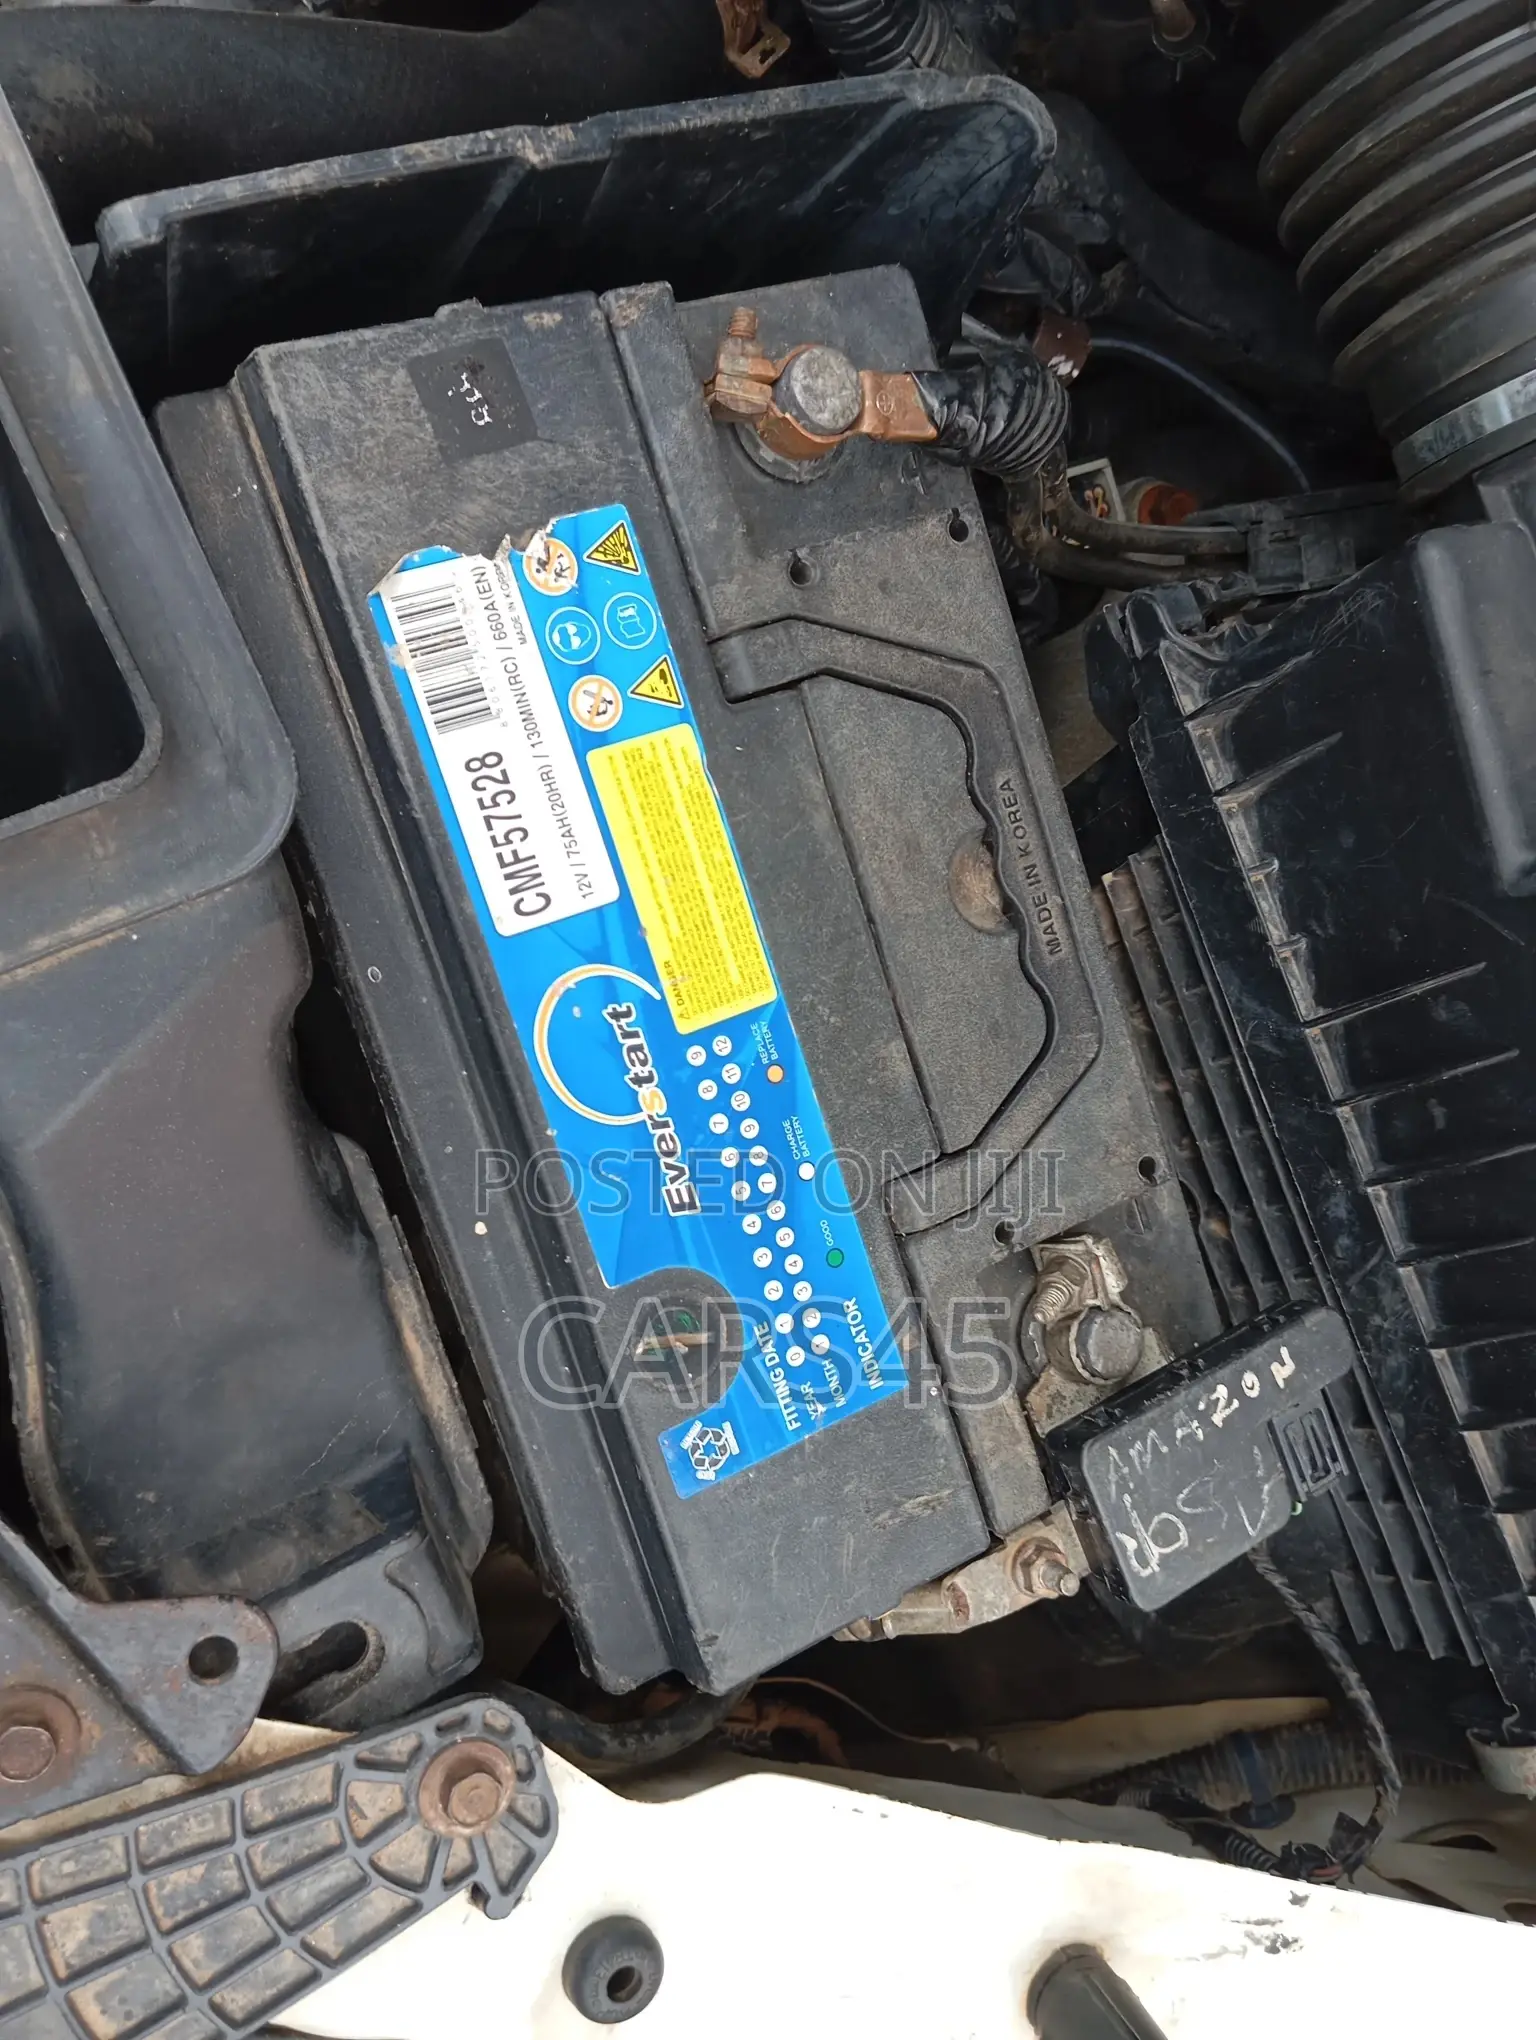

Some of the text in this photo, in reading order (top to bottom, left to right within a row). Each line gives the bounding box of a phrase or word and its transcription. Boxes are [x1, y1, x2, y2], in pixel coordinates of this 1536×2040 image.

[469, 563, 509, 643] 660A(EN)
[505, 600, 517, 613] IN
[509, 613, 528, 645] MADE
[500, 653, 545, 749] 130MIN(RC)
[462, 746, 555, 921] CMF57528
[536, 761, 582, 859] 75AH(20HR)
[573, 869, 596, 900] 12V
[996, 776, 1063, 956] MADE IN KOREA
[749, 1021, 770, 1064] REPLACE
[758, 1018, 779, 1060] BATTERY
[602, 997, 702, 1221] Everstart
[781, 1118, 802, 1160] CHARGE
[789, 1113, 811, 1158] BATTERY
[818, 1218, 835, 1247] GOOD
[841, 1296, 885, 1390] INDICATOR
[752, 1320, 802, 1431] FITTING DATE
[820, 1356, 847, 1408] MONTH
[799, 1380, 822, 1420] YEAR
